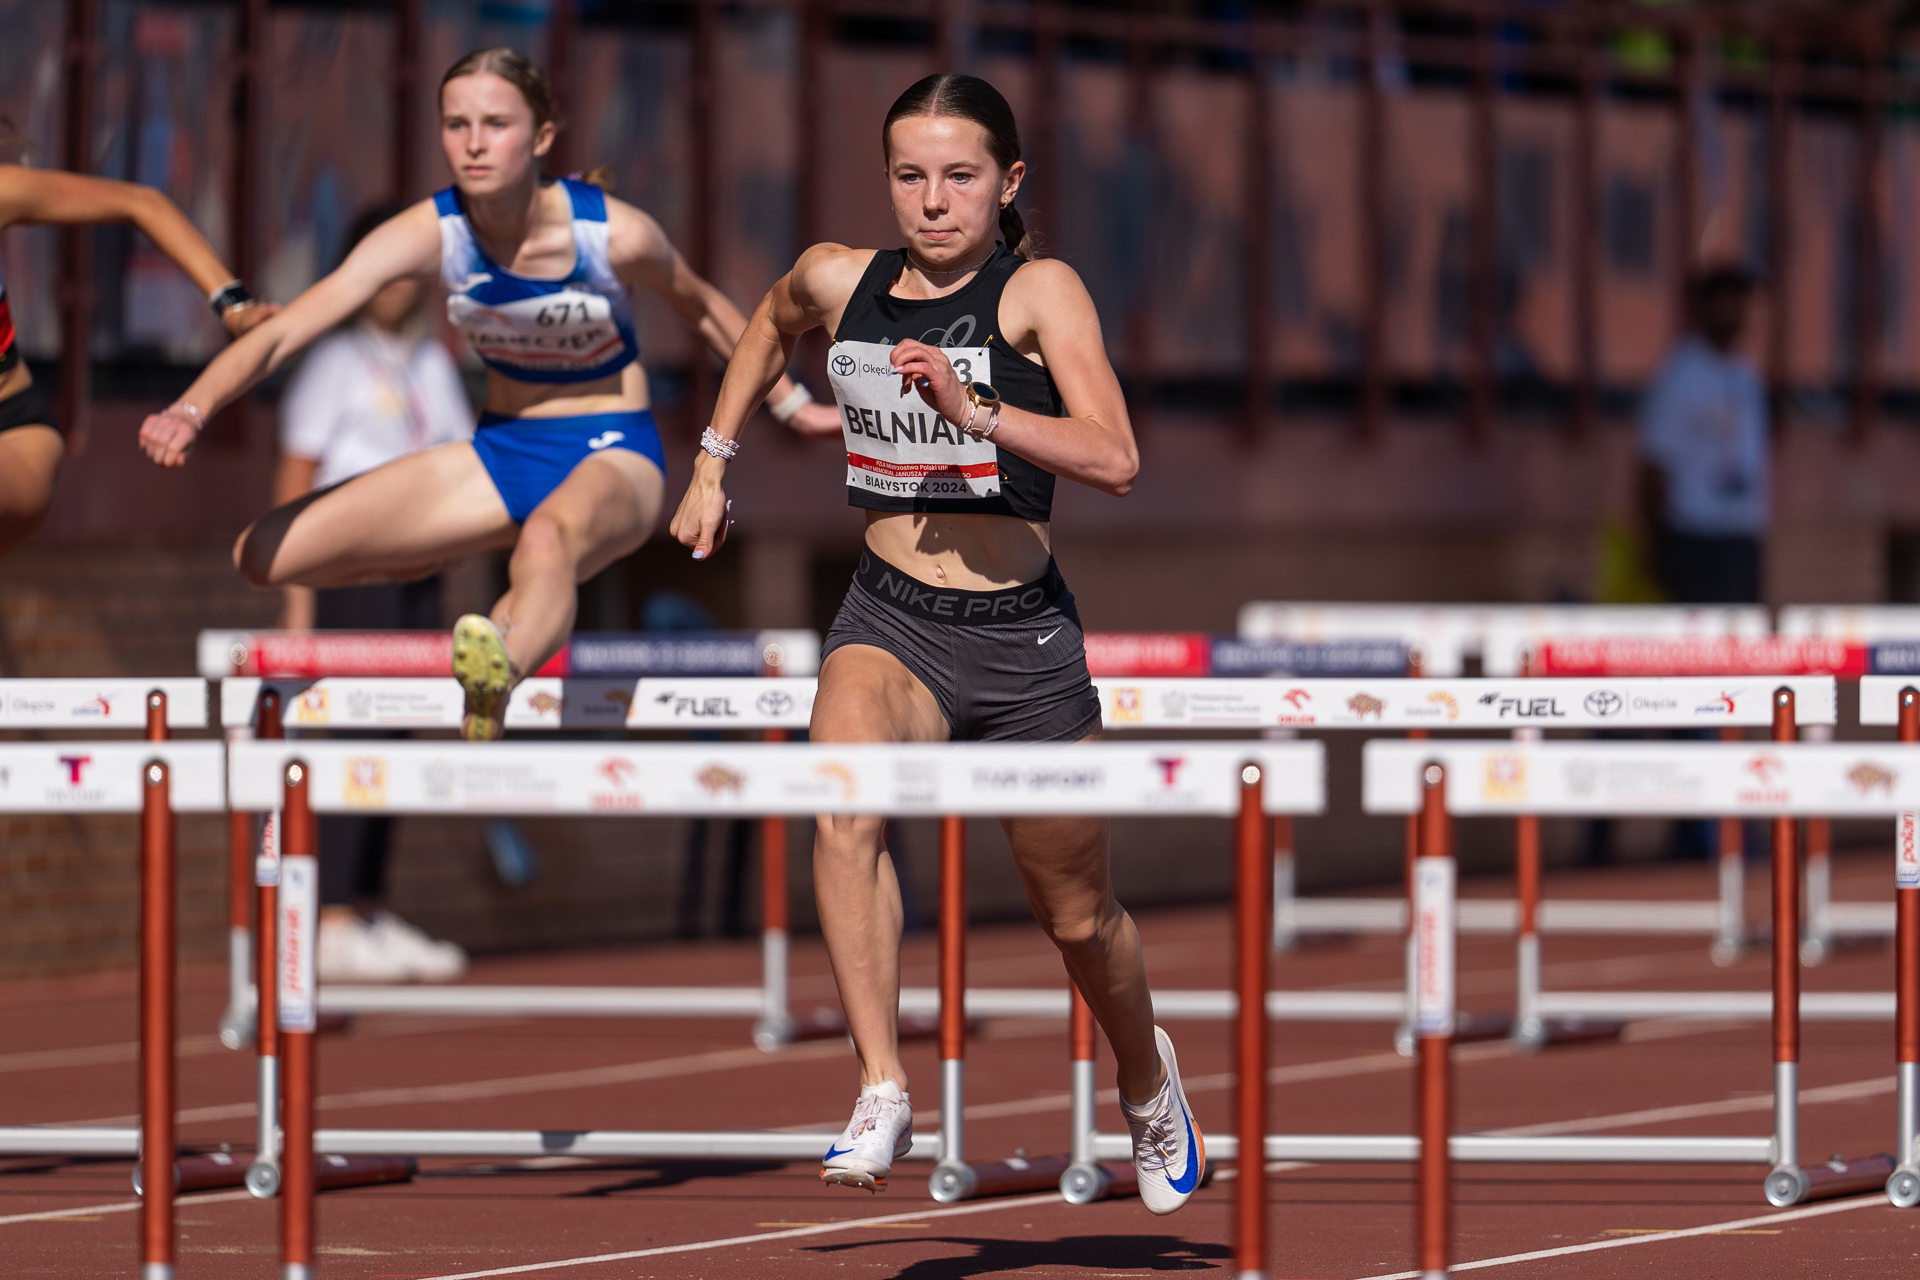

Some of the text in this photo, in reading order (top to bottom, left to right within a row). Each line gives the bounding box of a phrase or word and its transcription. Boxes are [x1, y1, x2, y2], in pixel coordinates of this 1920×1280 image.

[536, 302, 592, 327] 671
[862, 363, 890, 376] Okęci
[887, 463, 919, 471] Mistrzostwa
[865, 475, 968, 493] BIAŁYSTOK 2024
[876, 570, 1046, 618] NIKE PRO
[1500, 698, 1566, 717] FUEL
